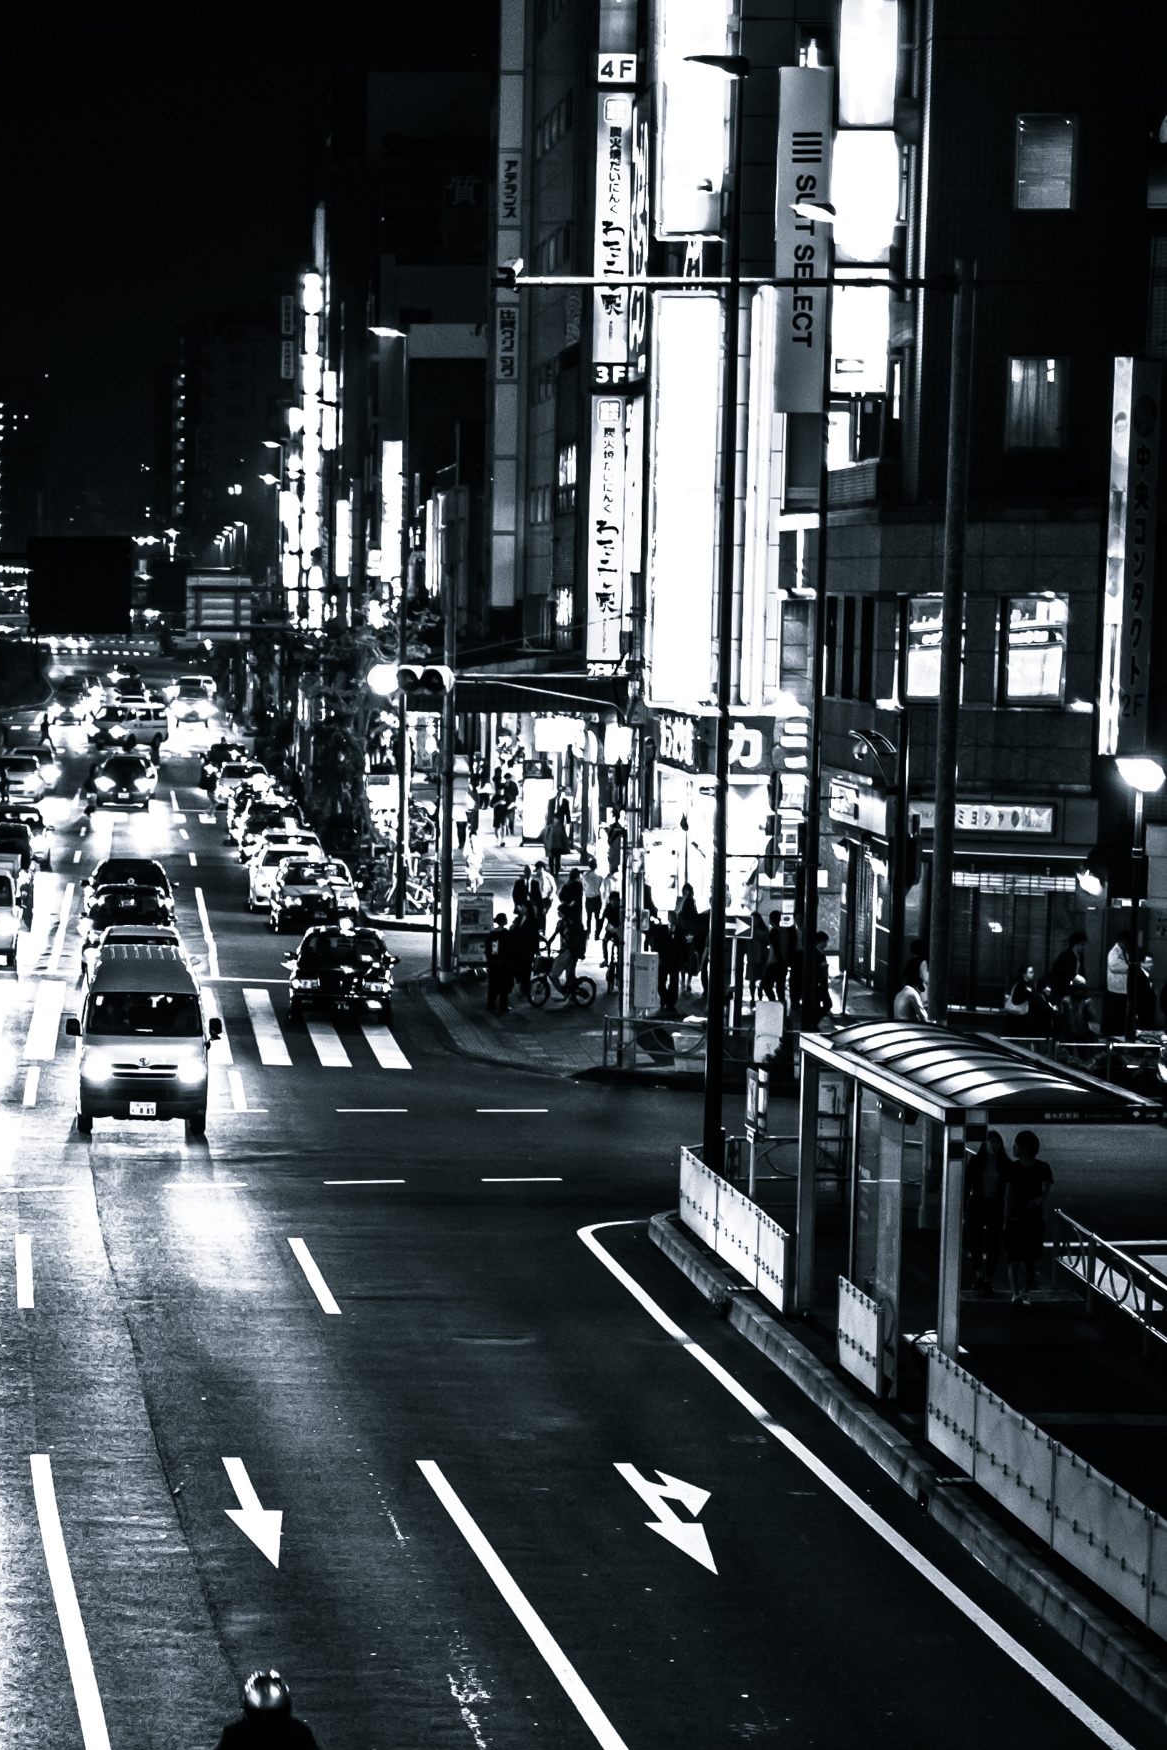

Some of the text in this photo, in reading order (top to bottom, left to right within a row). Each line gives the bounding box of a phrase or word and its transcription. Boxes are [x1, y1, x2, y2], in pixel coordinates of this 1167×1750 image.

[600, 60, 634, 79] 4F
[795, 174, 818, 237] SUT
[596, 365, 626, 384] 3F
[1129, 444, 1151, 686] 中央コンタクト
[1120, 693, 1144, 719] 2F
